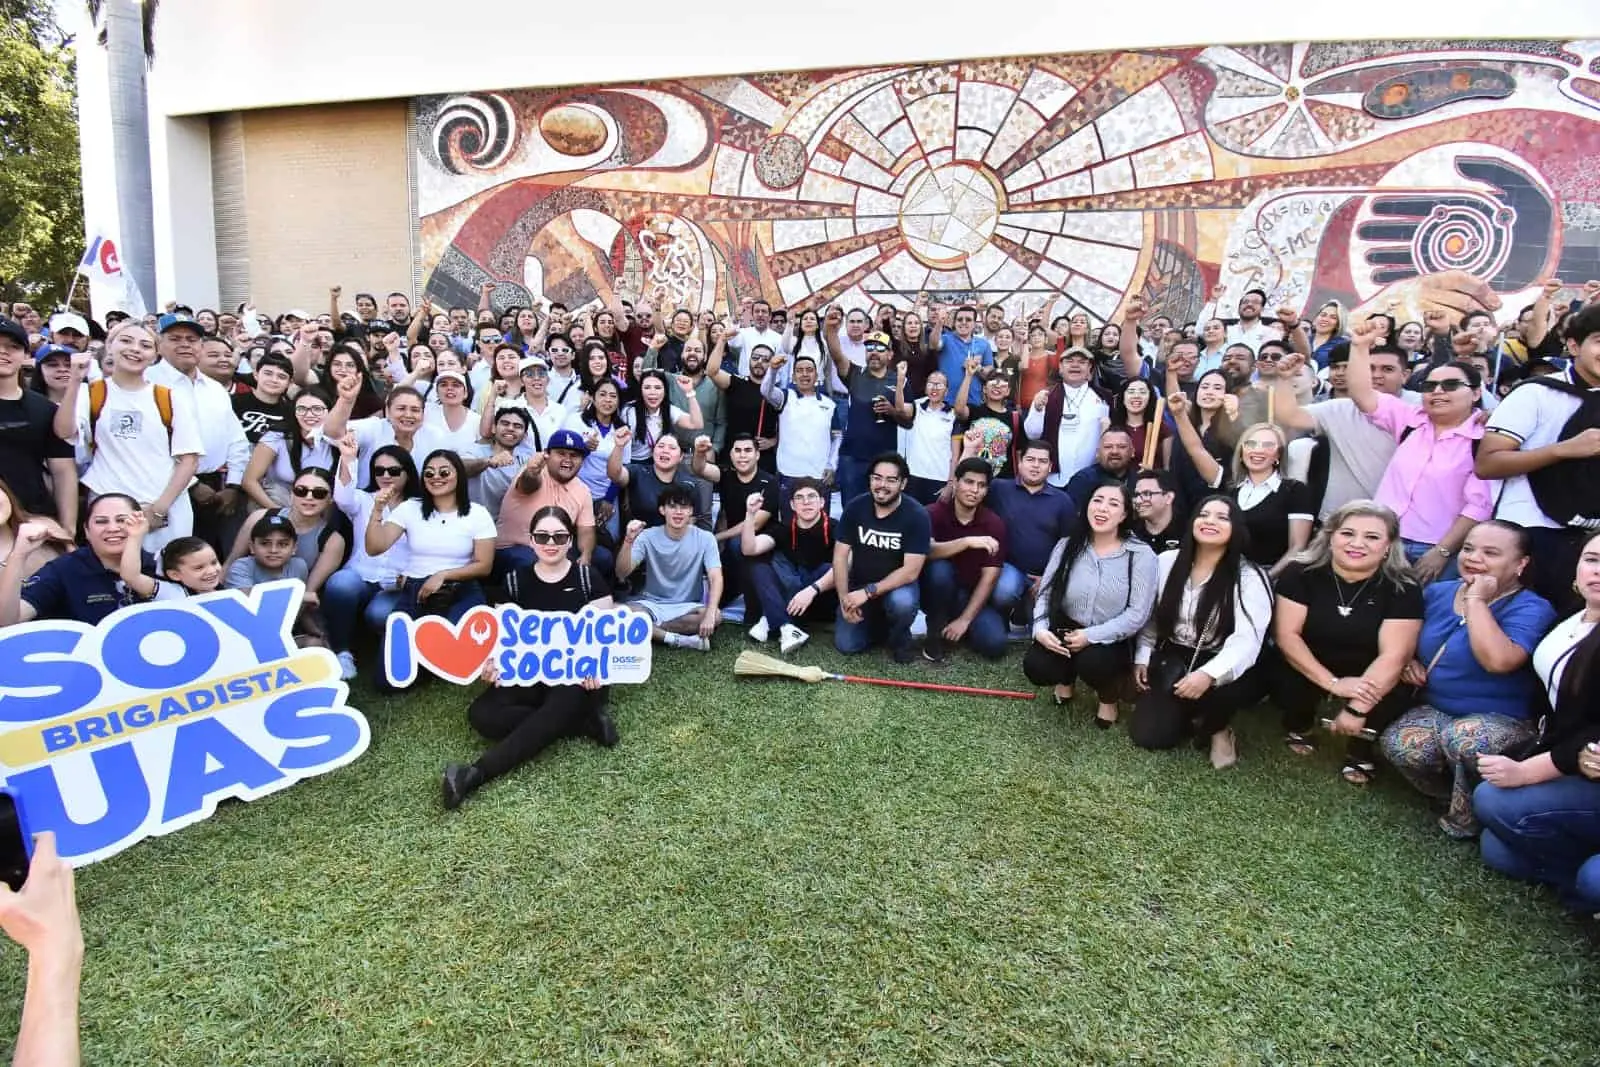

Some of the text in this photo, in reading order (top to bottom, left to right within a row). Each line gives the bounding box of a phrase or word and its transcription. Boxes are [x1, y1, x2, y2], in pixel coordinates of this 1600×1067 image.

[858, 525, 902, 550] VANS
[0, 587, 295, 722] SOY
[391, 618, 411, 682] I
[41, 667, 302, 753] BRIGADISTA
[6, 687, 361, 857] UAS
